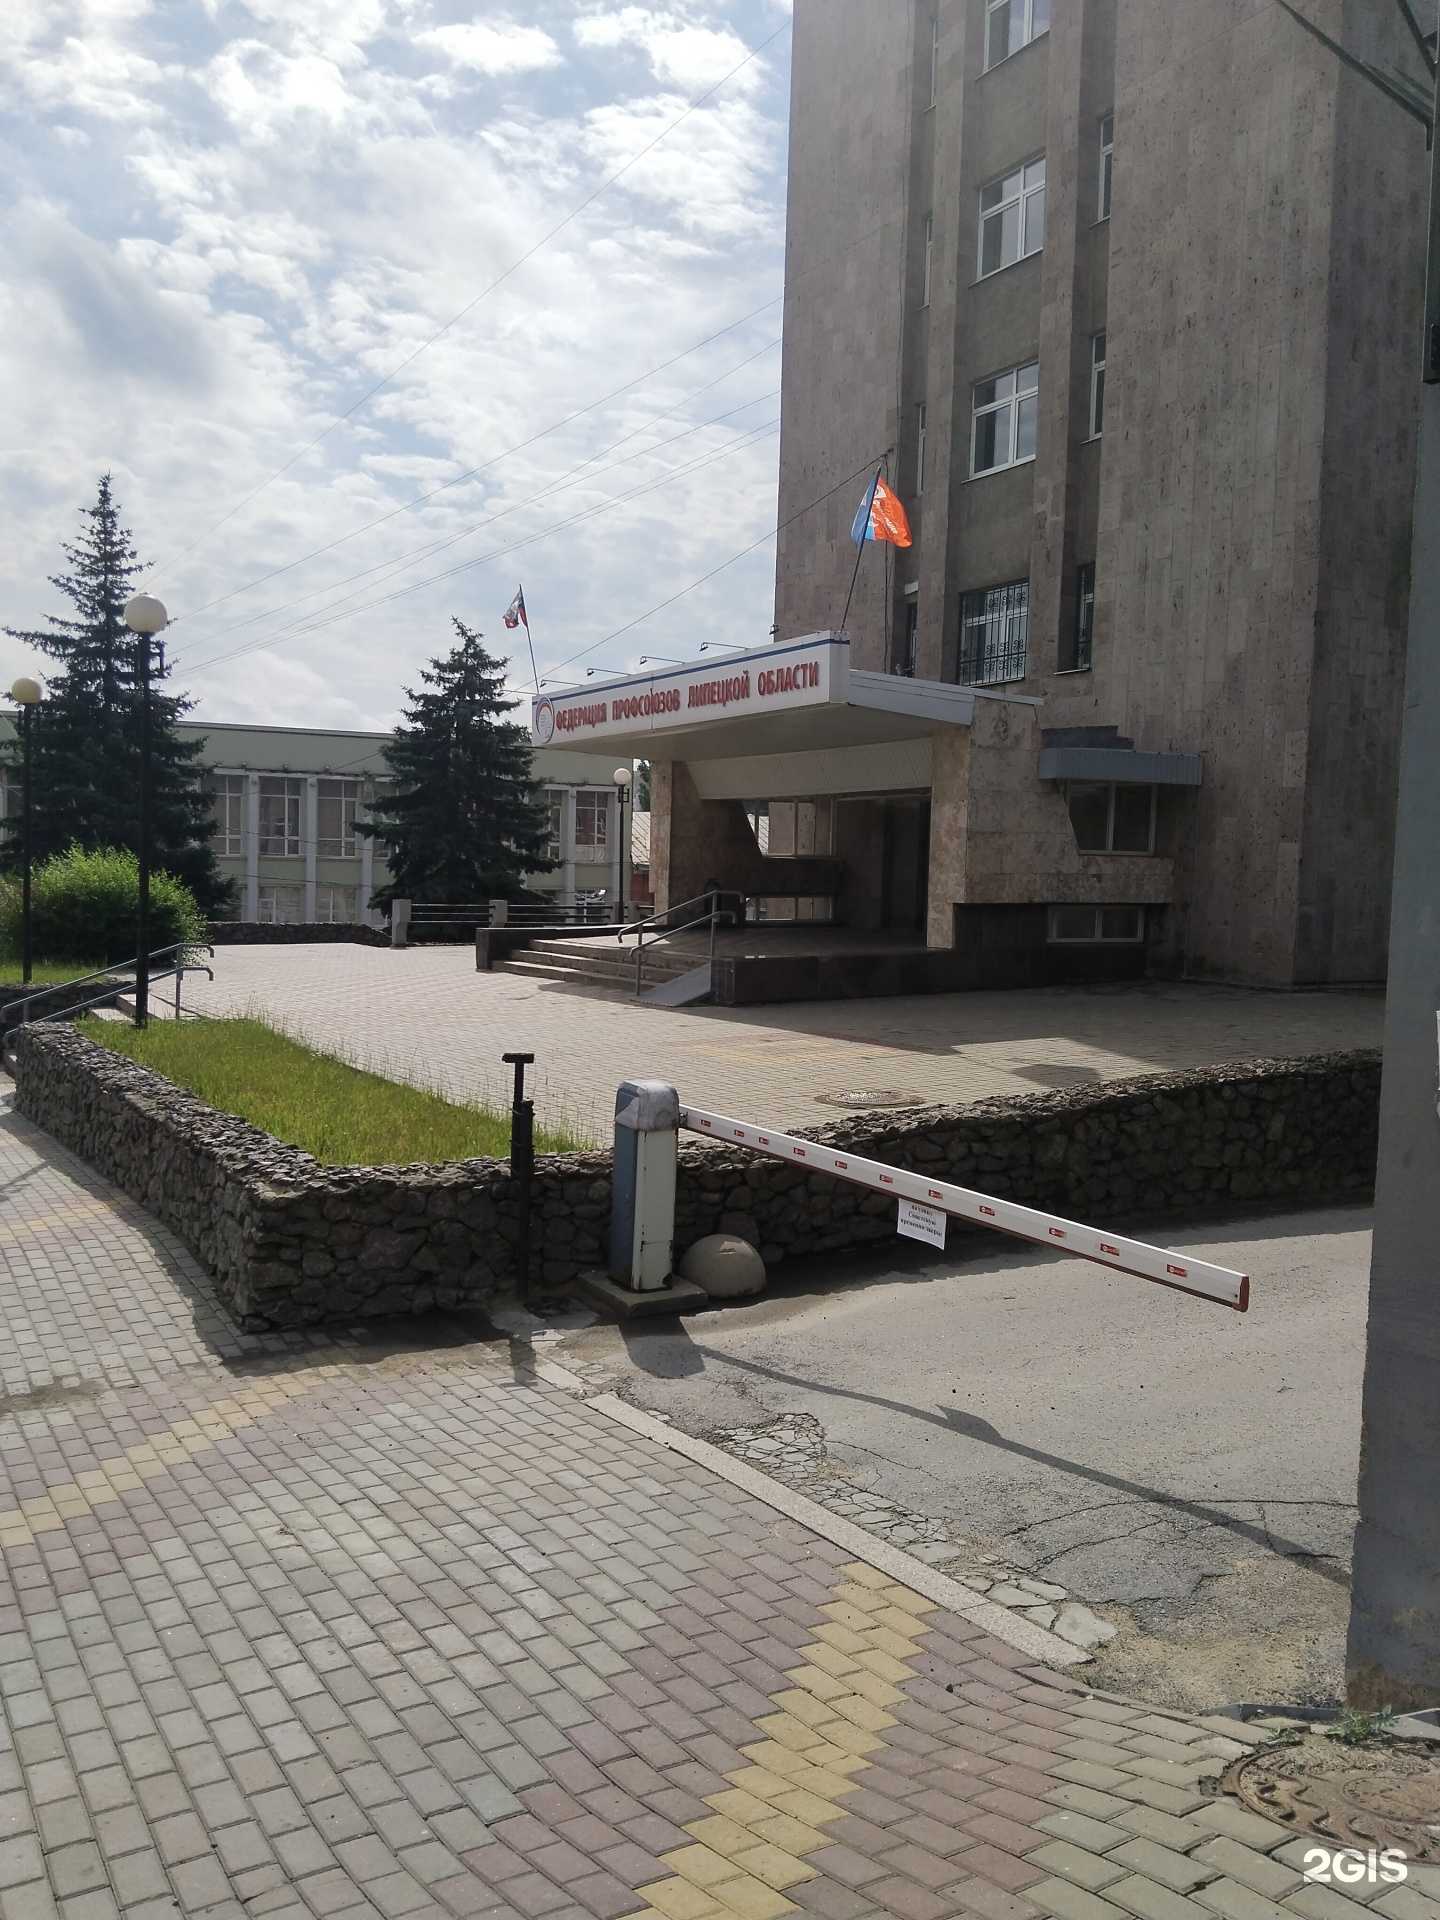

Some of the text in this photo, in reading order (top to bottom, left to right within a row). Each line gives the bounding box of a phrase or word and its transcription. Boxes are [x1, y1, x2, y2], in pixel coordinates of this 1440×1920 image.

[555, 702, 608, 732] ФЕДЕРАЦИЯ
[612, 688, 681, 721] ПРОФСОЮЗОВ
[687, 670, 750, 708] ЛИПЕЦКОЙ
[757, 660, 820, 696] ОБЛАСТИ
